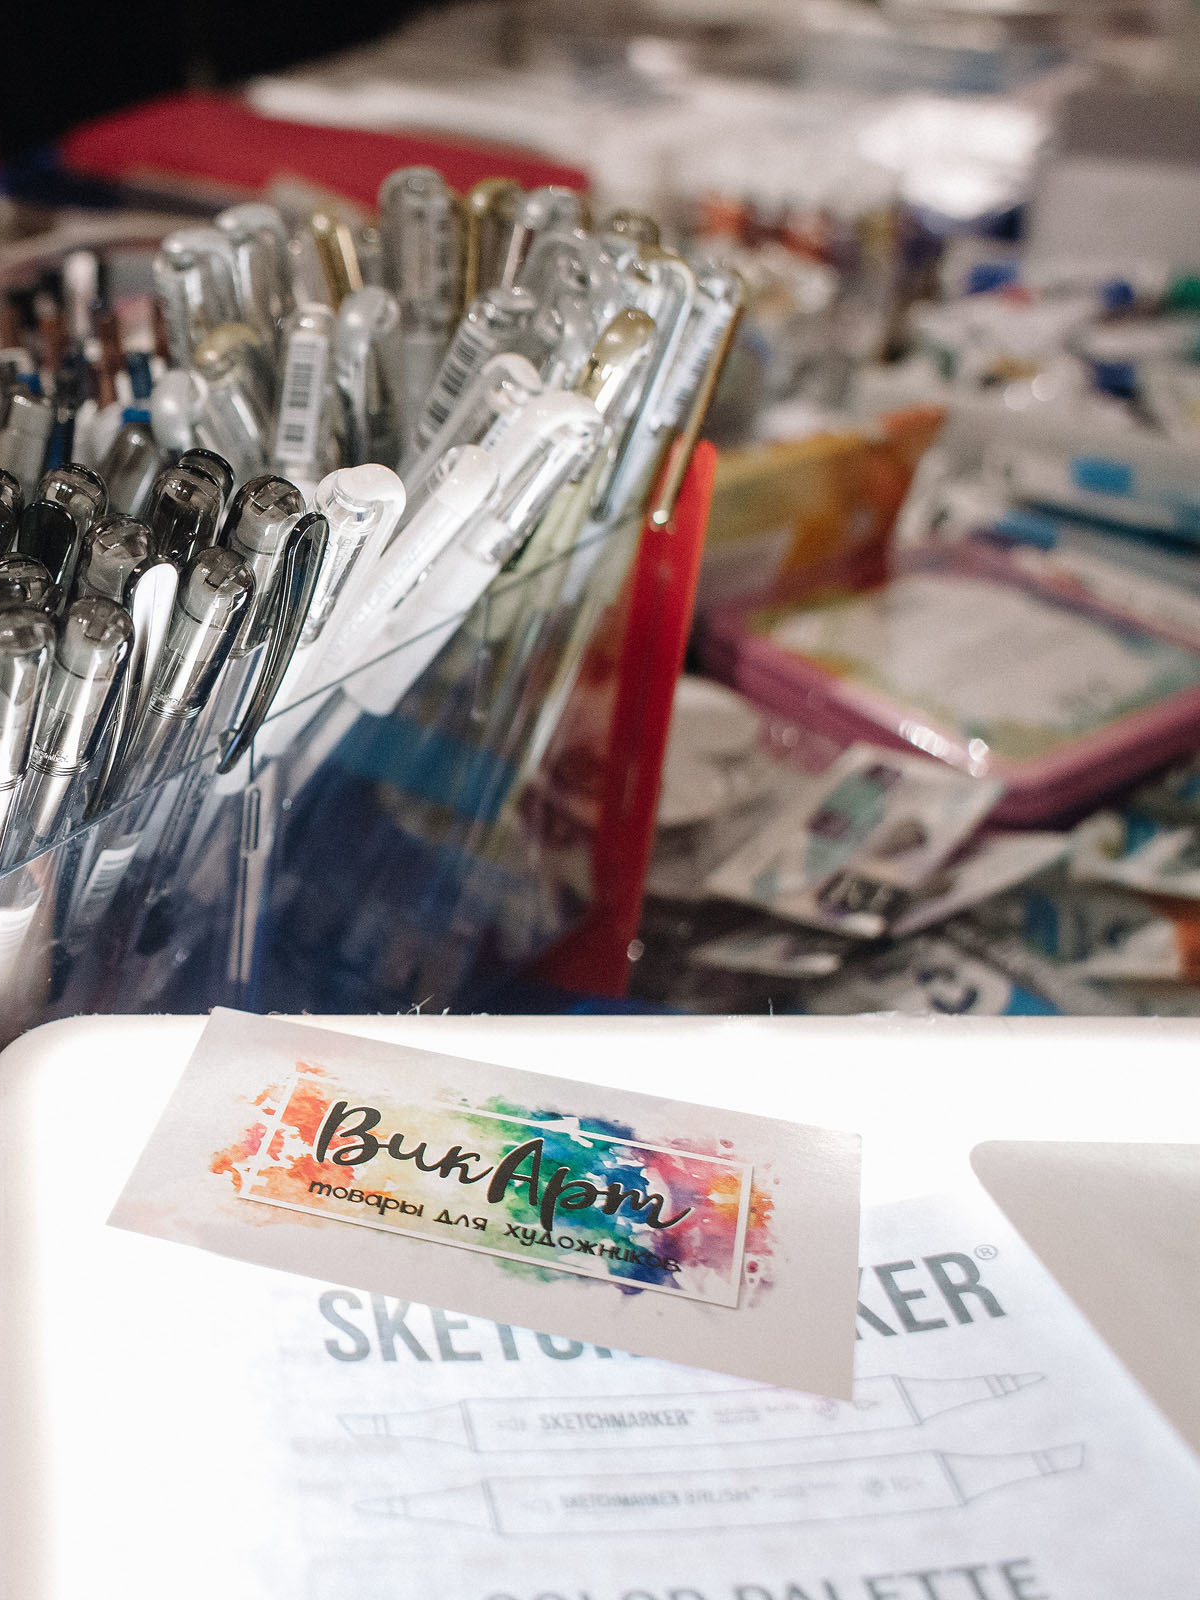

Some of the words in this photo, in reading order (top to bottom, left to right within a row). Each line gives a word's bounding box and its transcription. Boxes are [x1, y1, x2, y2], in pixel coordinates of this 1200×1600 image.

[315, 1100, 696, 1231] ВикАрт
[307, 1178, 424, 1218] товары
[432, 1209, 490, 1233] для
[503, 1222, 683, 1274] художников
